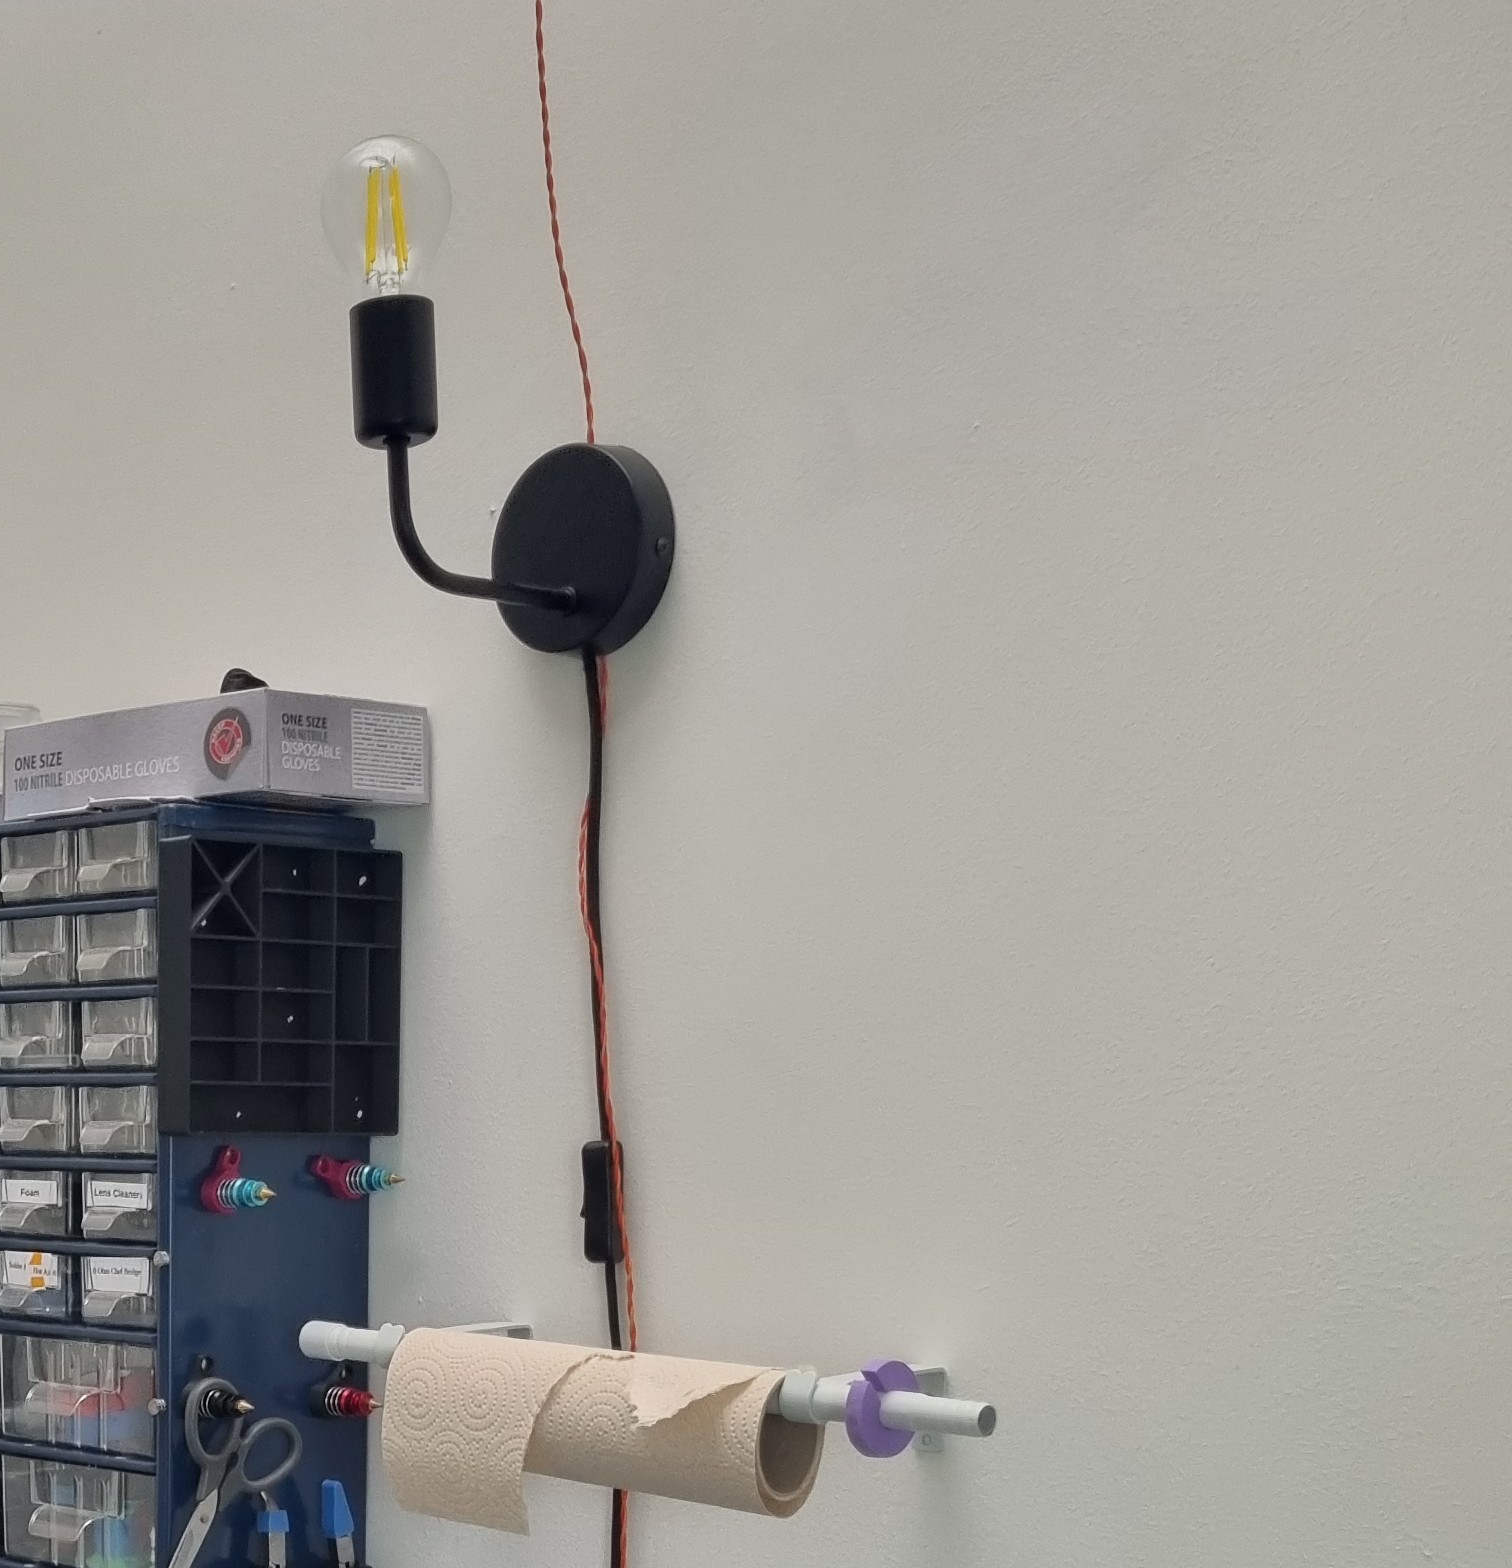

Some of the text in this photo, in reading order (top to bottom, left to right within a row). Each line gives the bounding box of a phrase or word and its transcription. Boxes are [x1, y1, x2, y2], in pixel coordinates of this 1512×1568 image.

[281, 712, 327, 729] ONE SIZE
[281, 741, 341, 760] DISPOSABLE
[14, 751, 63, 771] ONE SIZE
[281, 756, 321, 772] GLOVES
[14, 755, 180, 792] 100 NITRILE DISPOSABLE GLOVES
[20, 1187, 40, 1197] Foam
[94, 1187, 111, 1198] Lens
